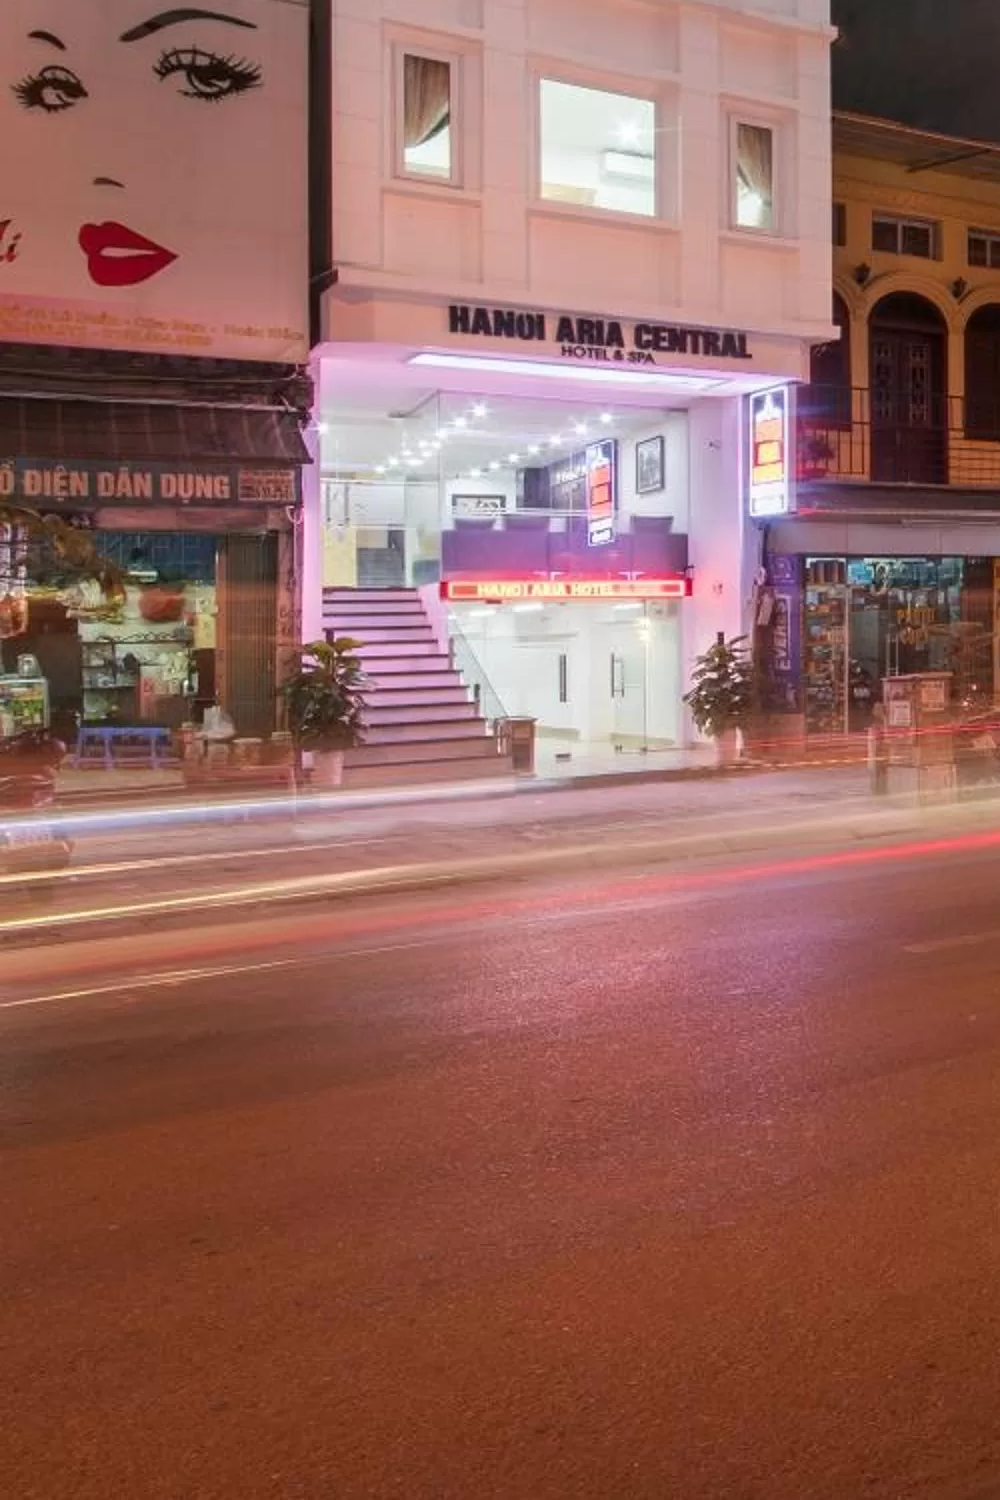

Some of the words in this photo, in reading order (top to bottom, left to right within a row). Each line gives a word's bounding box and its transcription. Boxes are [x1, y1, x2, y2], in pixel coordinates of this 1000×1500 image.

[448, 305, 545, 341] HANOI
[555, 316, 625, 348] ARIA
[633, 323, 753, 359] CENTRAL
[561, 344, 611, 361] HOTEL
[613, 348, 625, 361] &
[628, 351, 657, 365] SPA
[22, 464, 89, 502] ĐIỆN
[96, 466, 153, 498] DÂN
[160, 472, 231, 504] DỤNG
